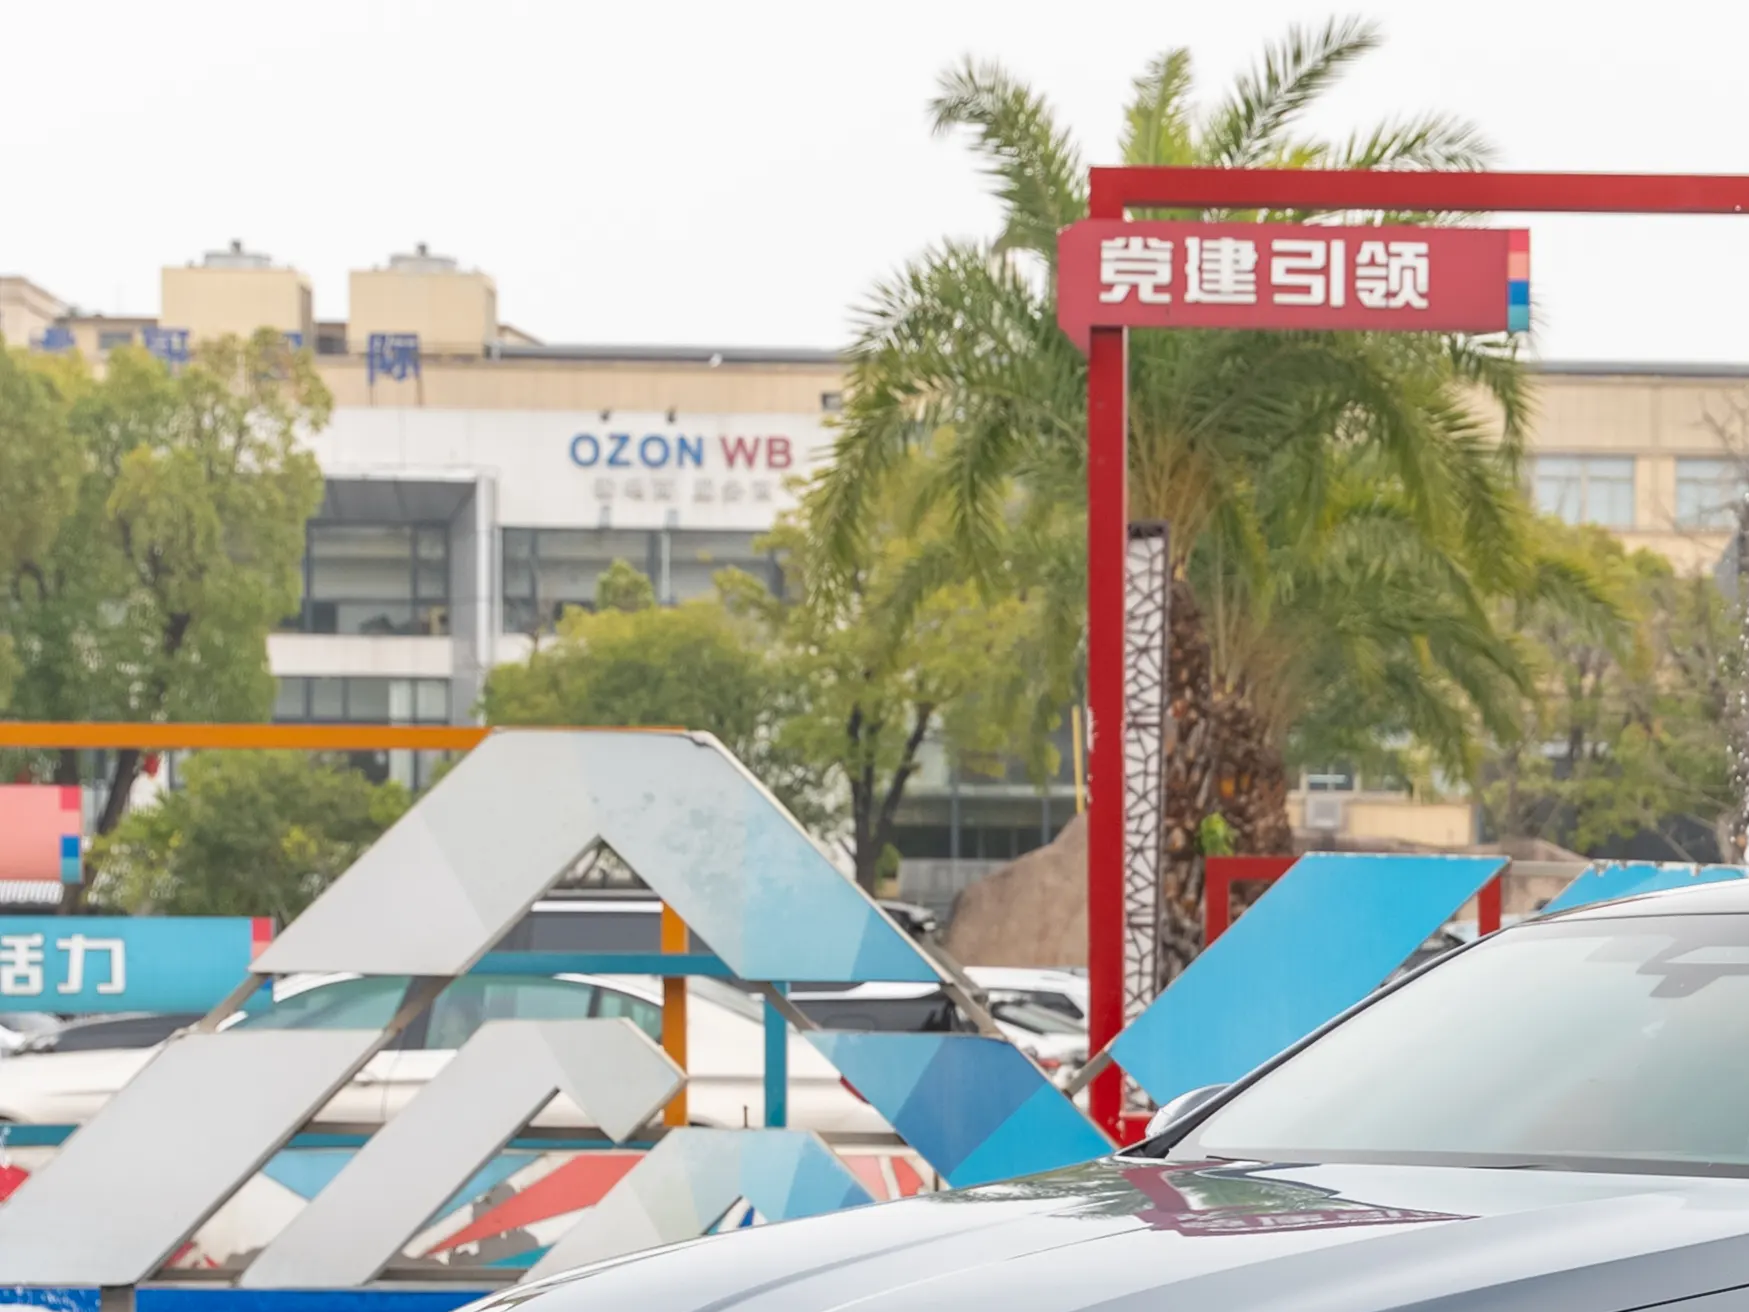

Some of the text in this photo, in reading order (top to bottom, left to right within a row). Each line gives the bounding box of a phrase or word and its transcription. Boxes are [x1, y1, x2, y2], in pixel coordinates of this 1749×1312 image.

[1100, 236, 1429, 310] 党建引领
[569, 432, 793, 470] OZON WB
